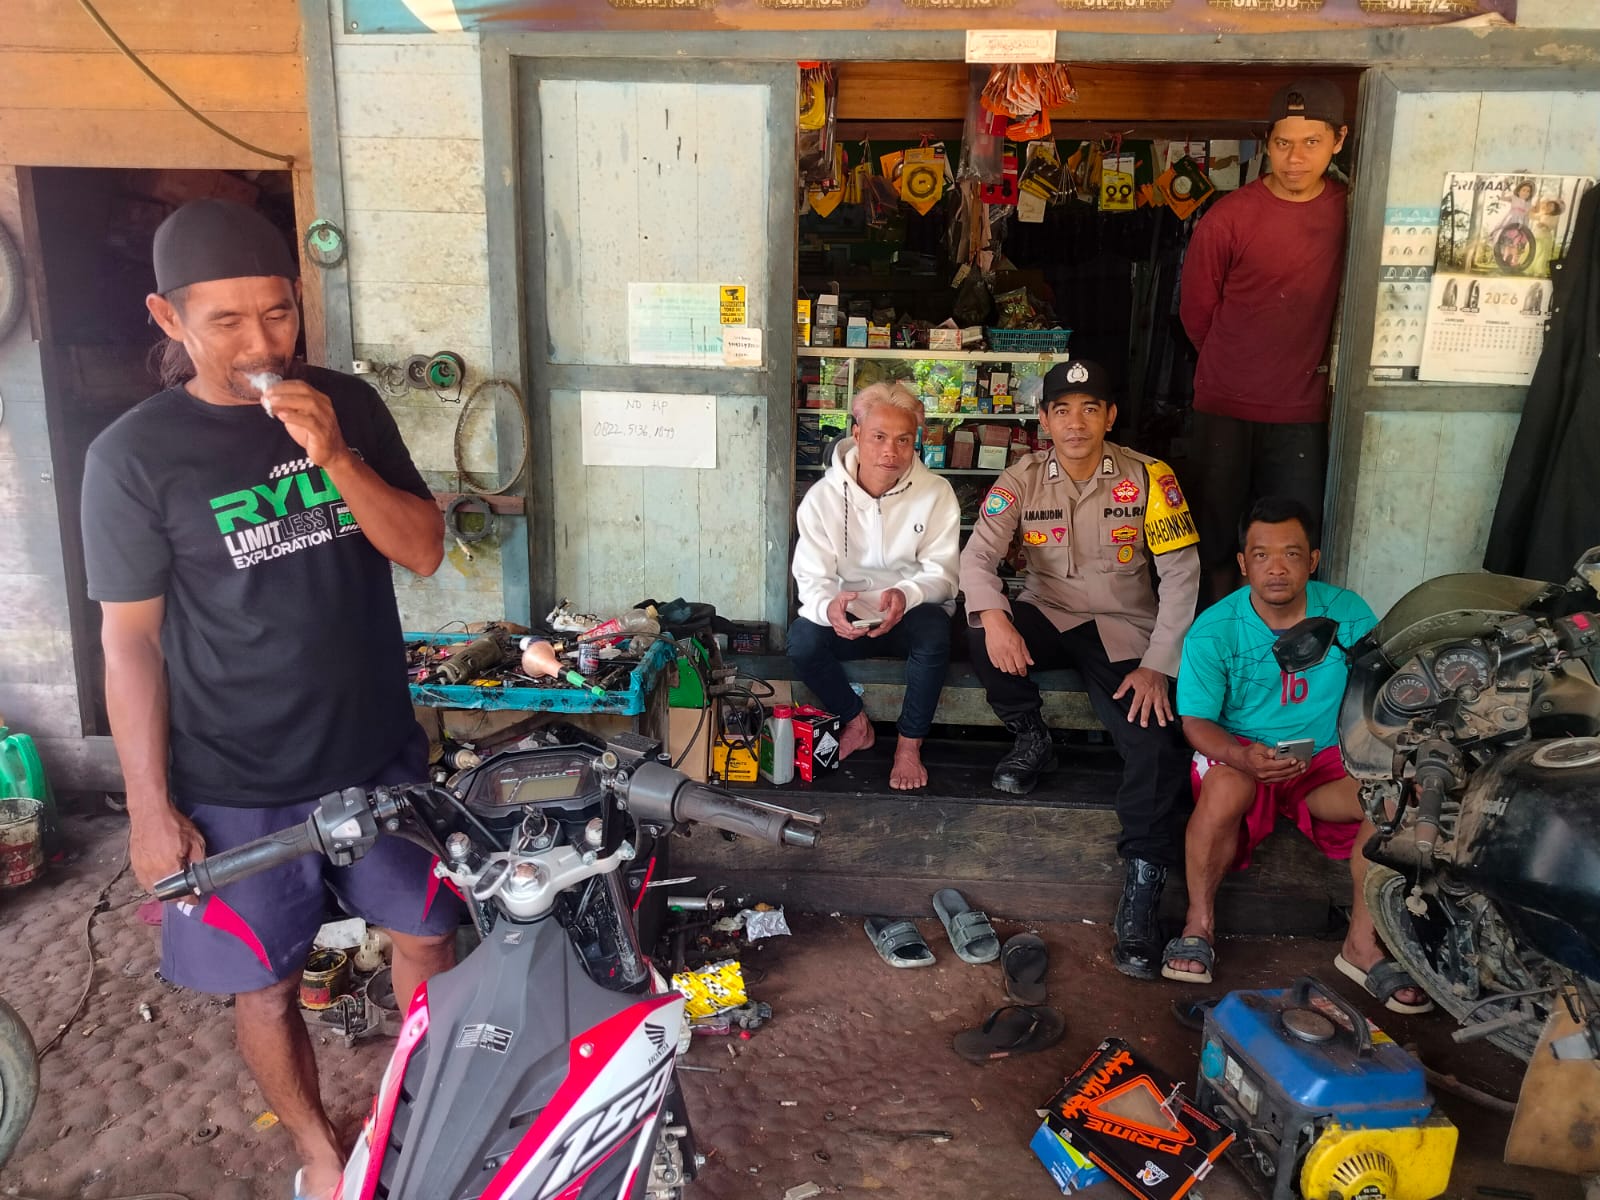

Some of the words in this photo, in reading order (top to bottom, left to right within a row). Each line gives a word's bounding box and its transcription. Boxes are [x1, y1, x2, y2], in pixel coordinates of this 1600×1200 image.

[1450, 180, 1513, 192] PRIMAAX
[1484, 291, 1518, 306] 2026
[233, 528, 333, 570] EXPLORATION
[647, 1042, 670, 1065] HONDA
[1083, 1116, 1183, 1156] PRIME
